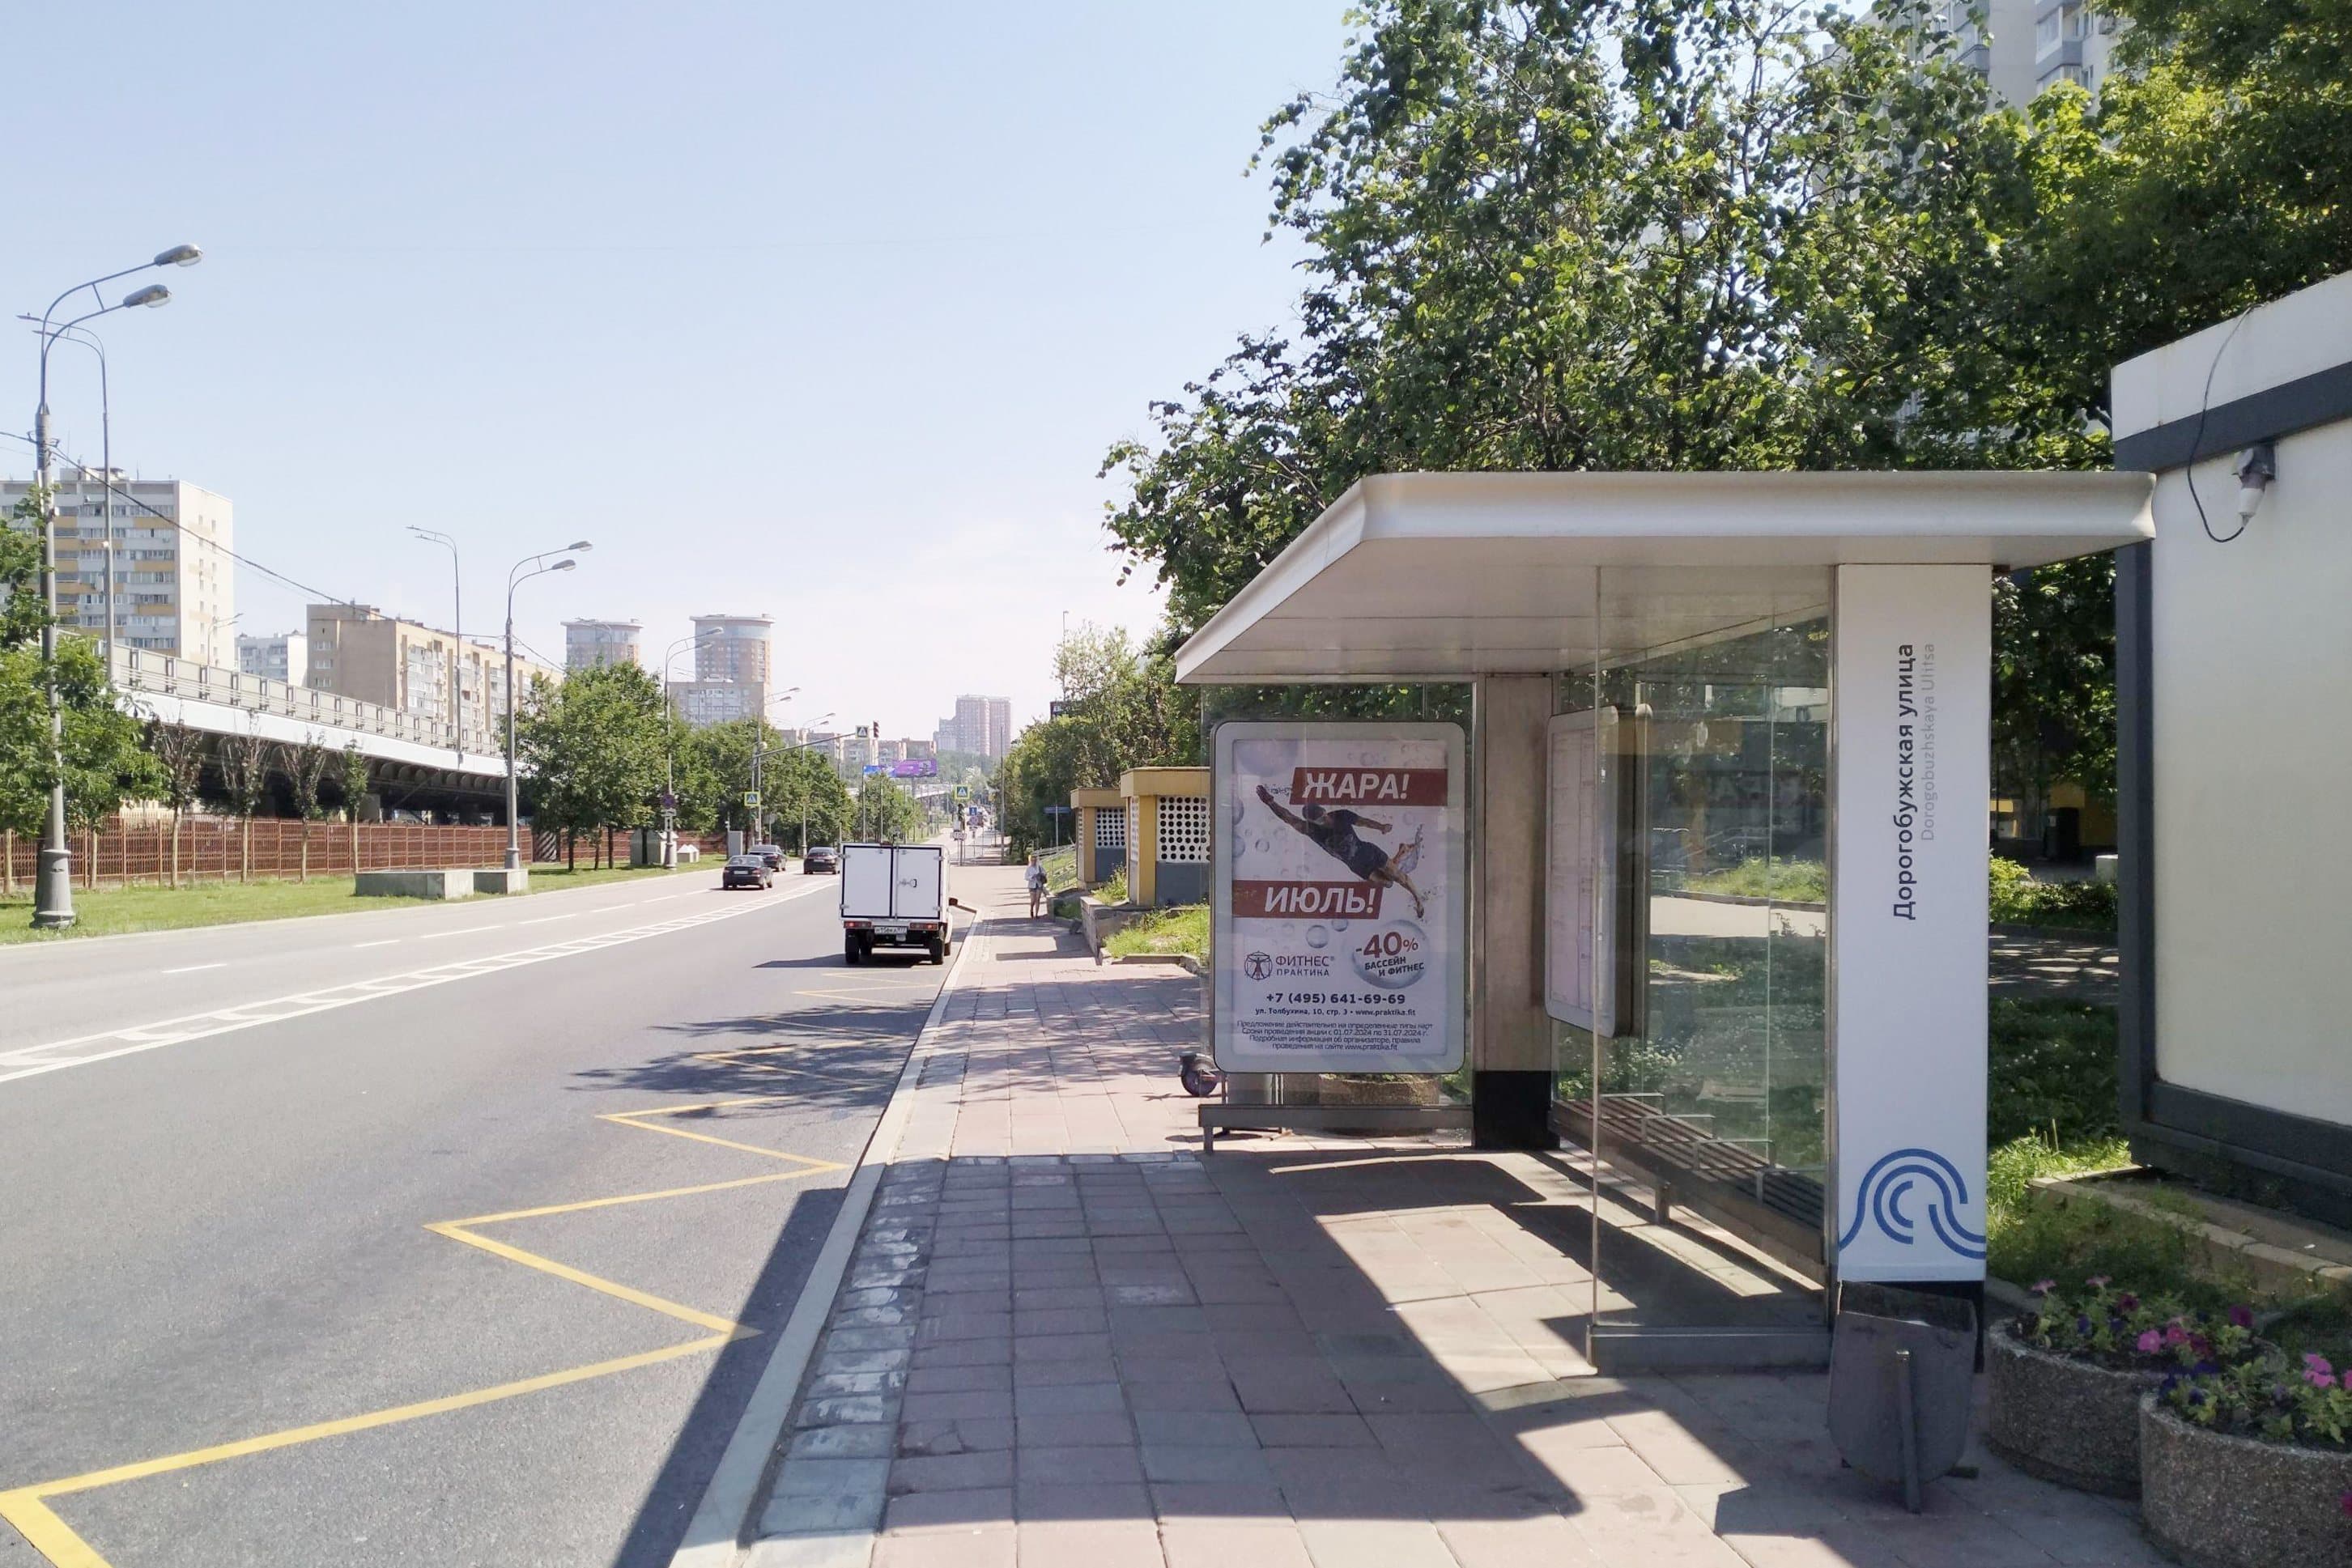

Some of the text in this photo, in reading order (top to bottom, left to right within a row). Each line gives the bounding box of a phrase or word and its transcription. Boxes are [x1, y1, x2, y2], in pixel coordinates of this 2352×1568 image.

[1920, 643, 1938, 842] Dorogobuzhskaya Ulitsa
[1301, 772, 1410, 800] ЖАРА!
[1893, 644, 1918, 920] Дорогобужская улица
[1265, 886, 1376, 914] ИЮЛЬ!
[1355, 931, 1419, 958] -40%
[1276, 969, 1330, 977] ПРАКТИКА
[1364, 956, 1407, 971] БАССЕЙН
[1378, 962, 1425, 977] И ФИТНЕС
[1266, 992, 1406, 1005] +7 (495) 641-69-69
[1255, 1008, 1266, 1016] ул.
